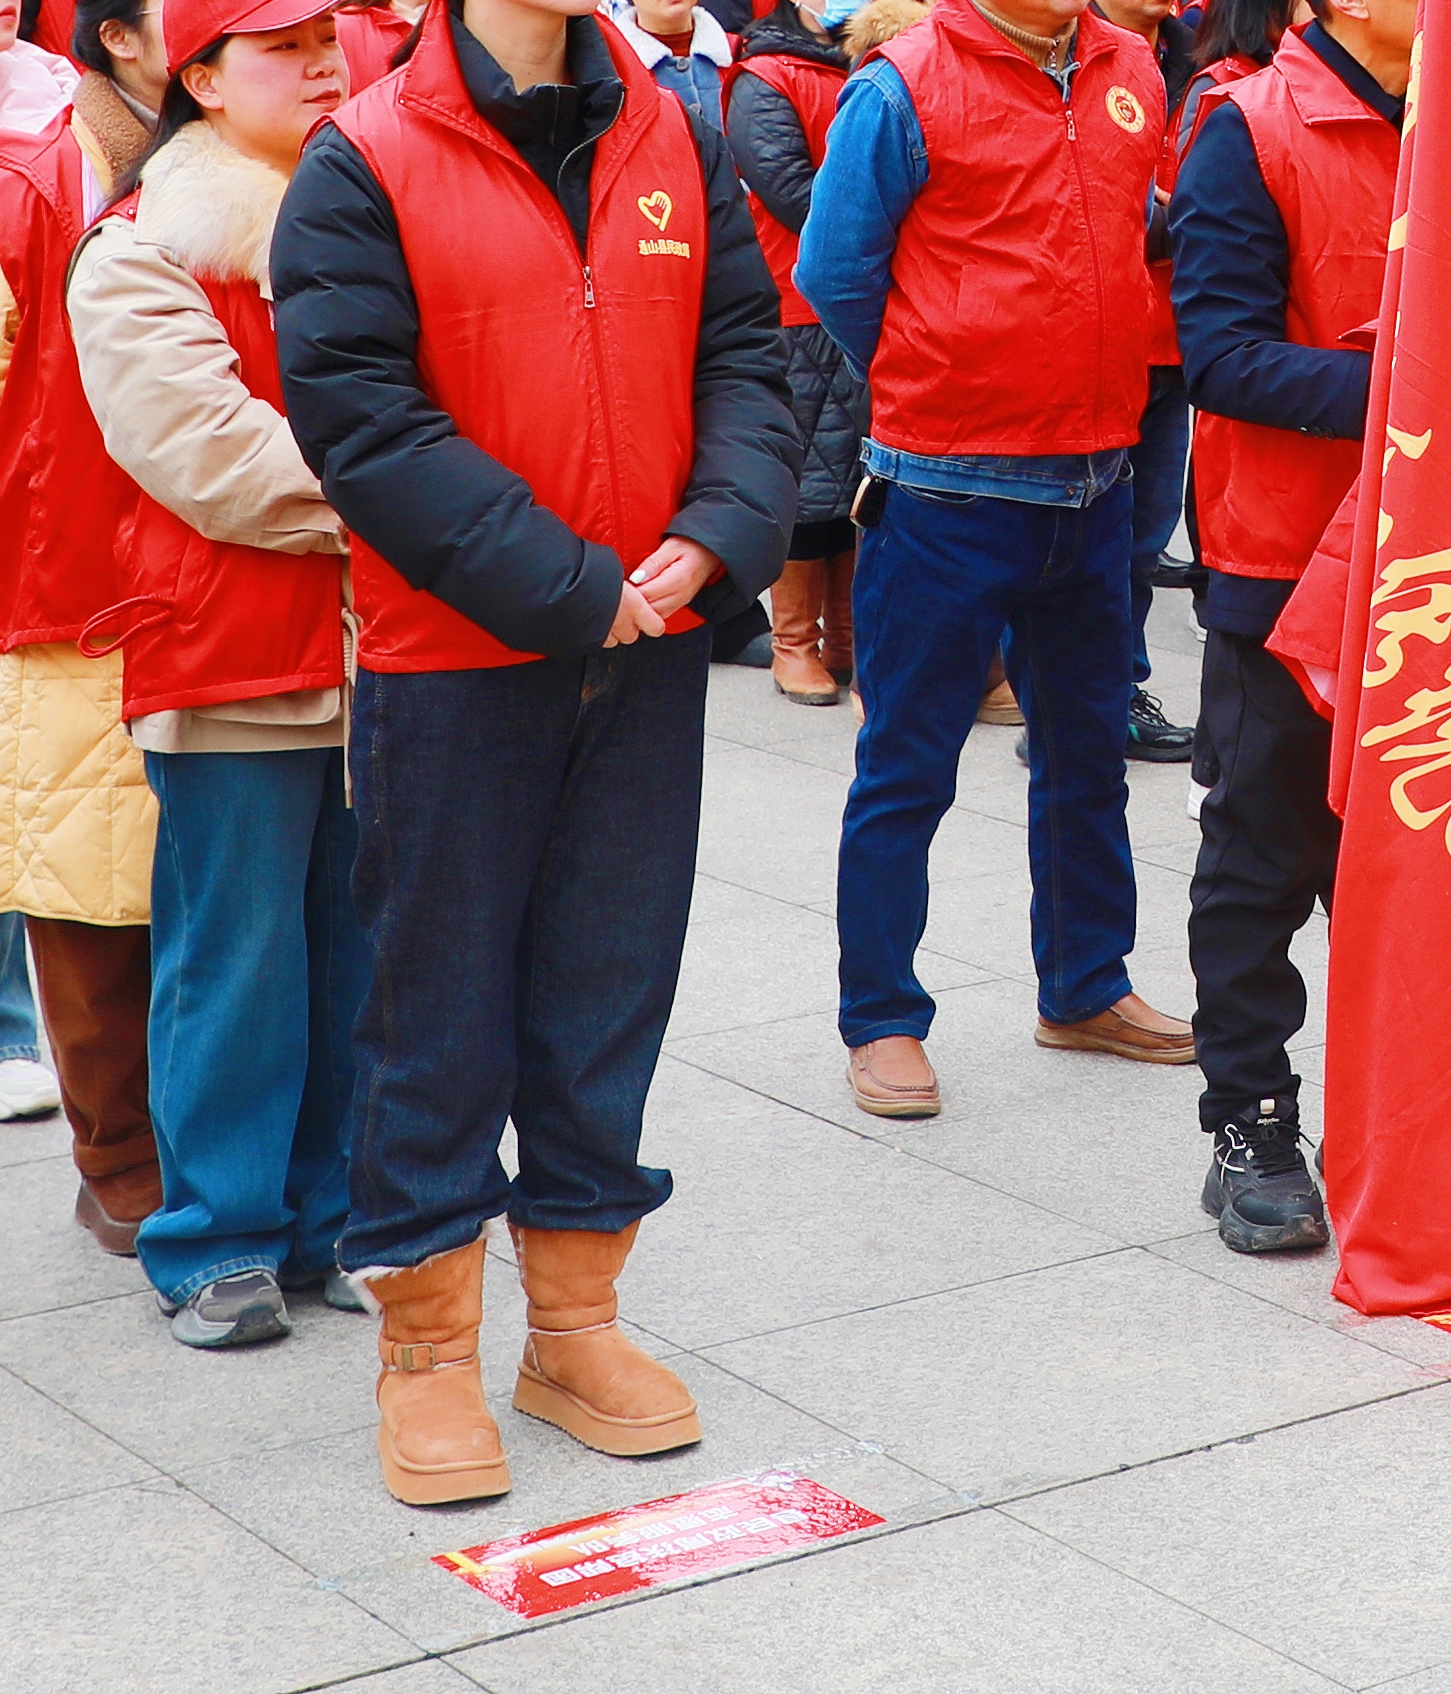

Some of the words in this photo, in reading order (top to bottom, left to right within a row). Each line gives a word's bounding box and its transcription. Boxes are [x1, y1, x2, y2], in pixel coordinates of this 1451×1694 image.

[638, 239, 690, 259] 通山县民政局
[566, 1504, 740, 1556] 志愿服务队
